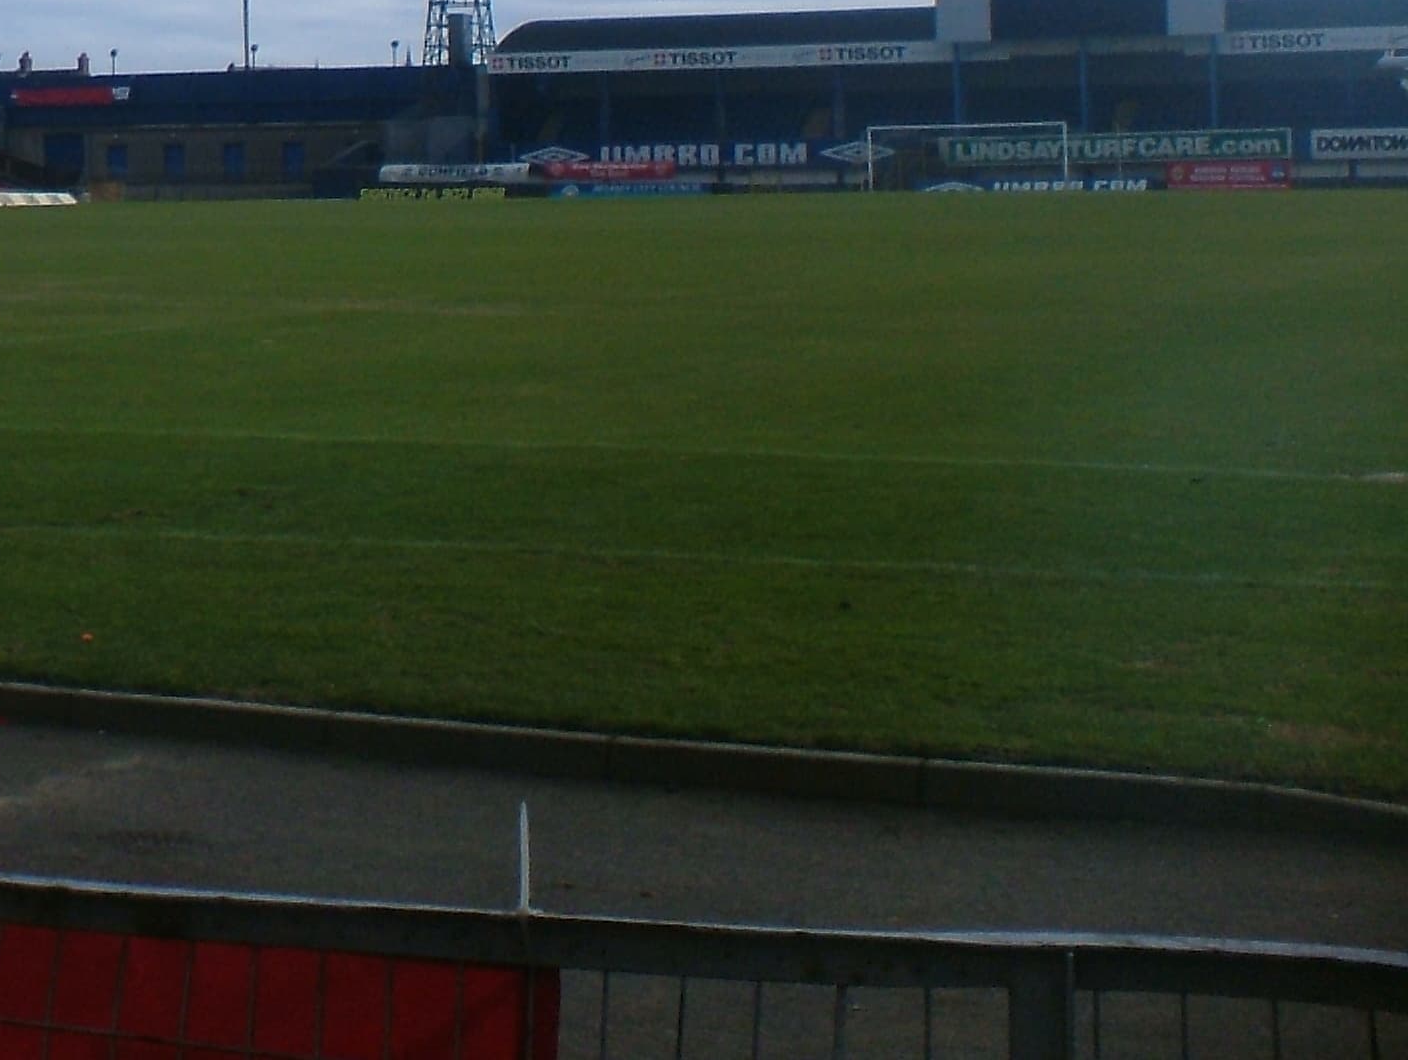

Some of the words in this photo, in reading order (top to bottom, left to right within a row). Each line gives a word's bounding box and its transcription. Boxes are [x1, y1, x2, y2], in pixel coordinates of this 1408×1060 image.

[1249, 32, 1324, 49] TISSOT
[669, 50, 738, 66] TISSOT
[836, 45, 907, 61] TISSOT
[509, 55, 571, 70] TISSOT
